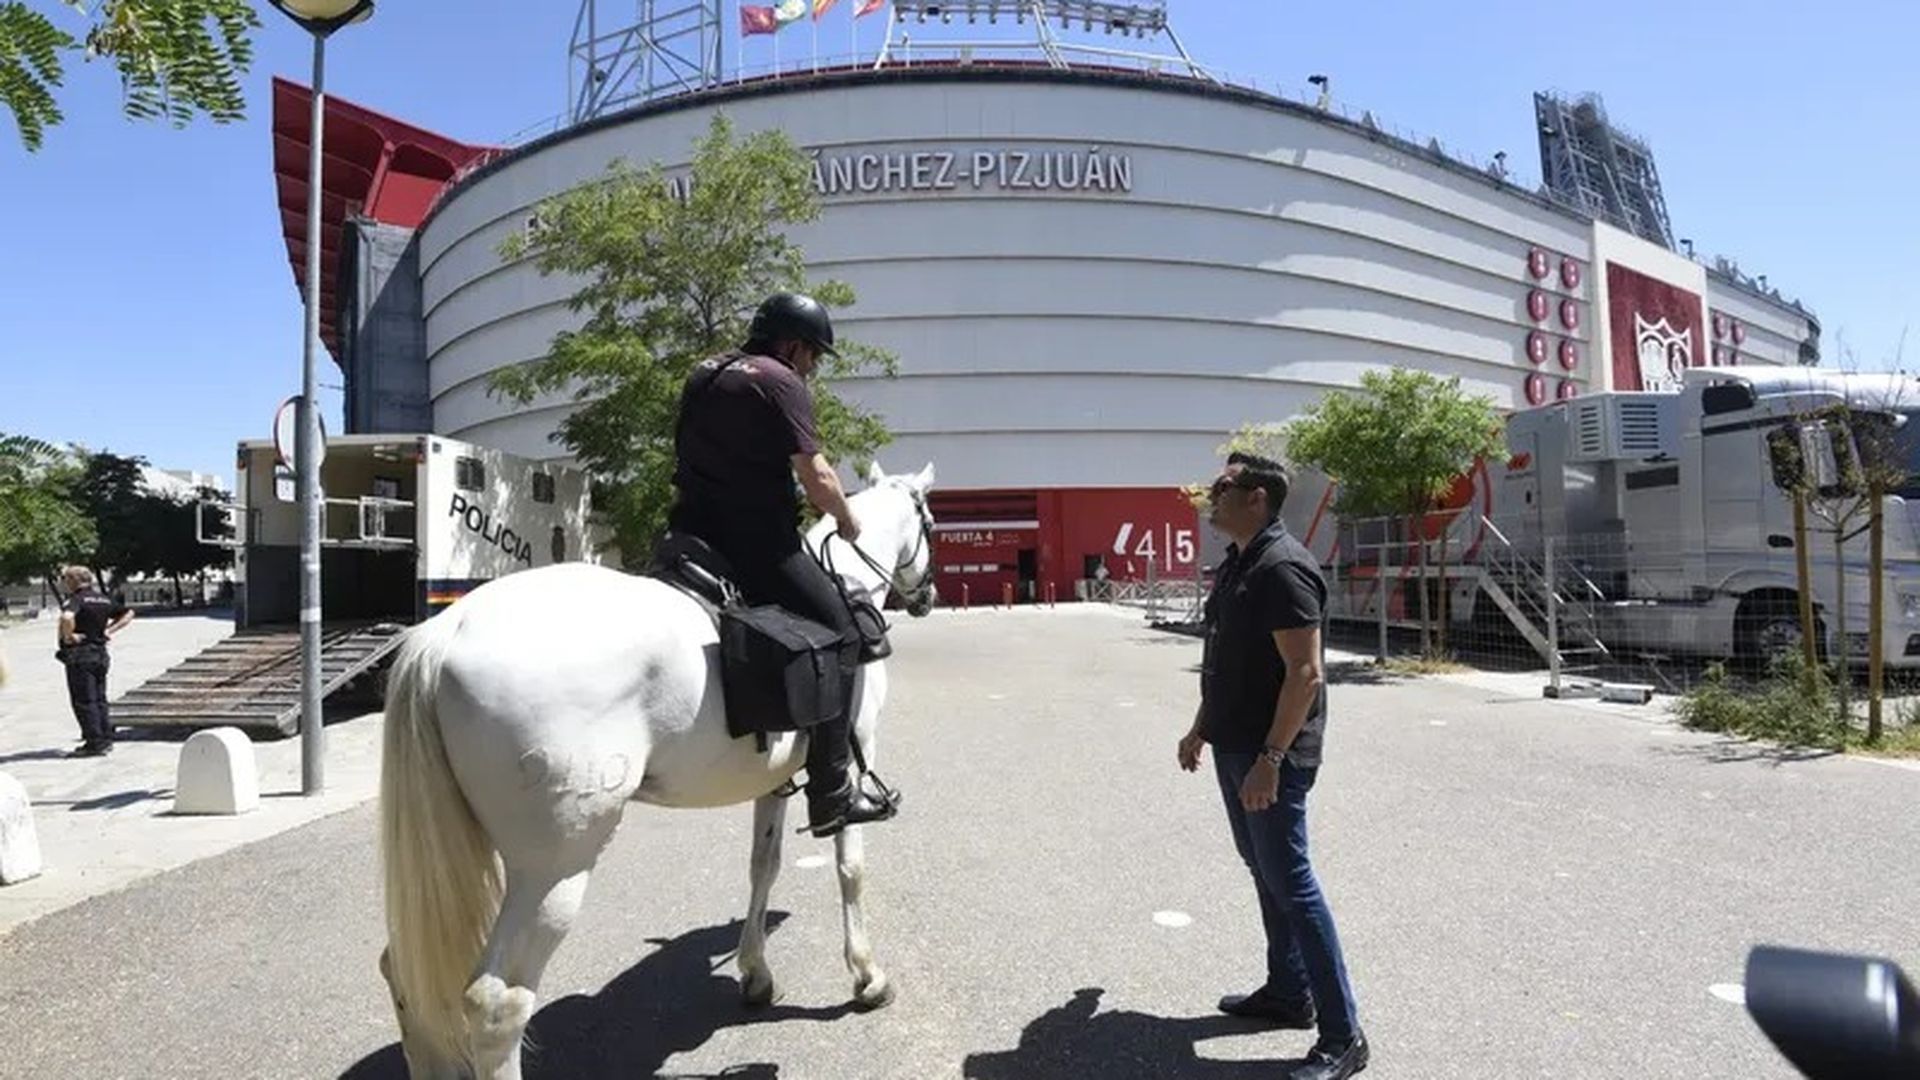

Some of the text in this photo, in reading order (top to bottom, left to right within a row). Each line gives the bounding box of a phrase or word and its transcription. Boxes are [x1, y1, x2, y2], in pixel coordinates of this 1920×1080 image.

[807, 147, 1133, 194] ÁNCHEZ-PIZJUÁN
[449, 493, 532, 567] POLICIA
[940, 531, 983, 543] PUERTA
[1177, 529, 1194, 563] 5
